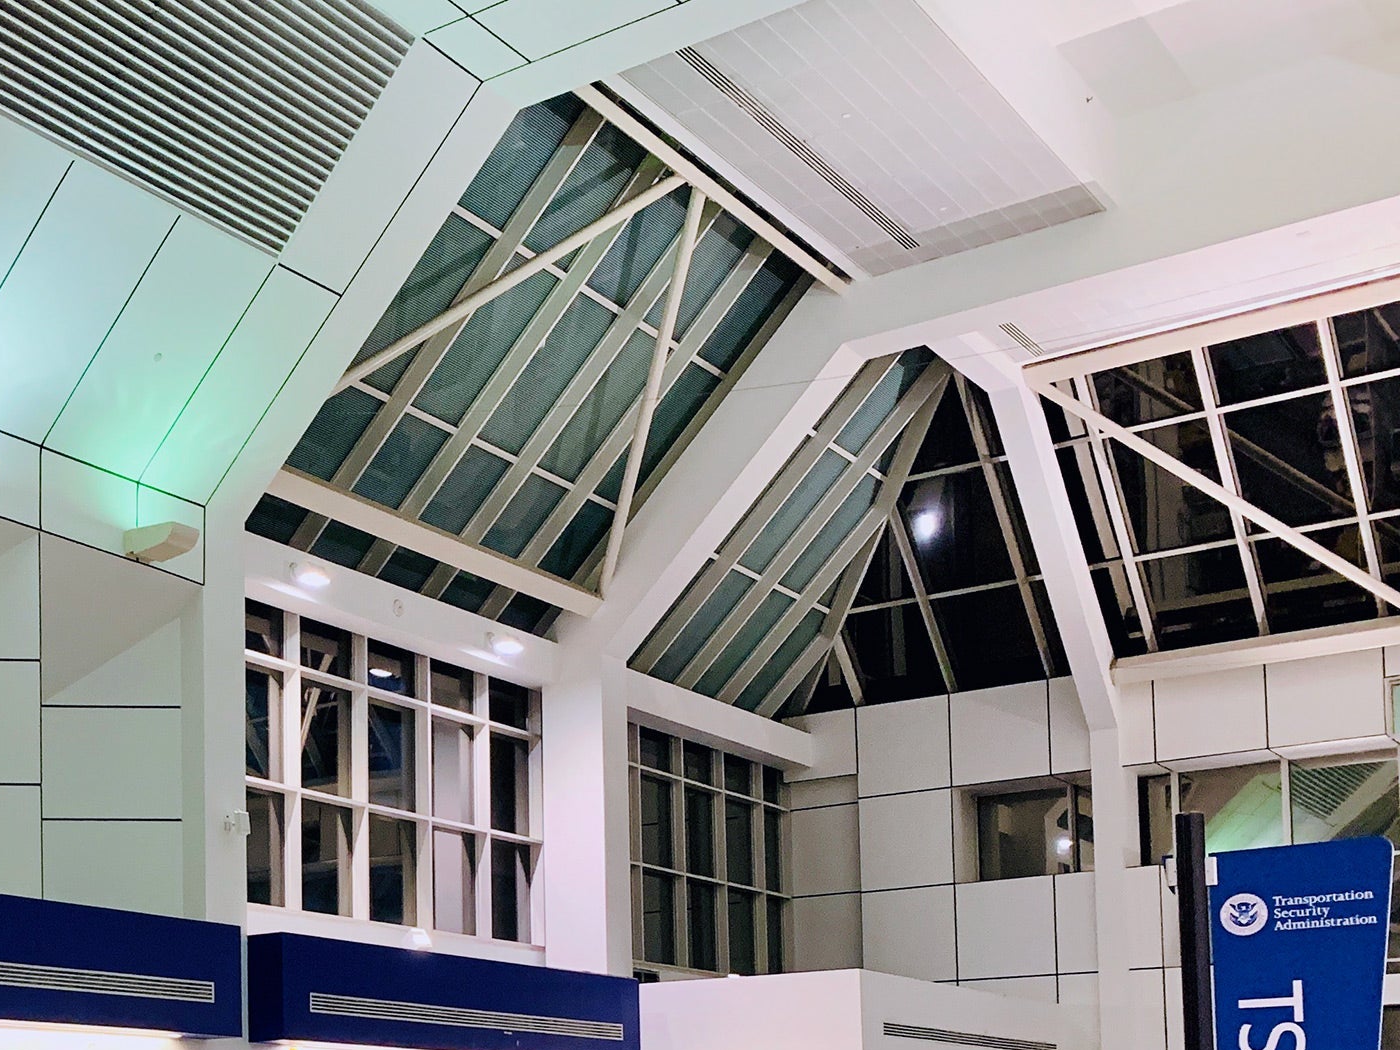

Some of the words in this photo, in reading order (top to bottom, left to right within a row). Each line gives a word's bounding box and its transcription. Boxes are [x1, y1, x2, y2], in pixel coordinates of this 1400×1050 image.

[1272, 890, 1375, 907] Transportation
[1273, 906, 1331, 919] Security
[1274, 914, 1378, 931] Administration
